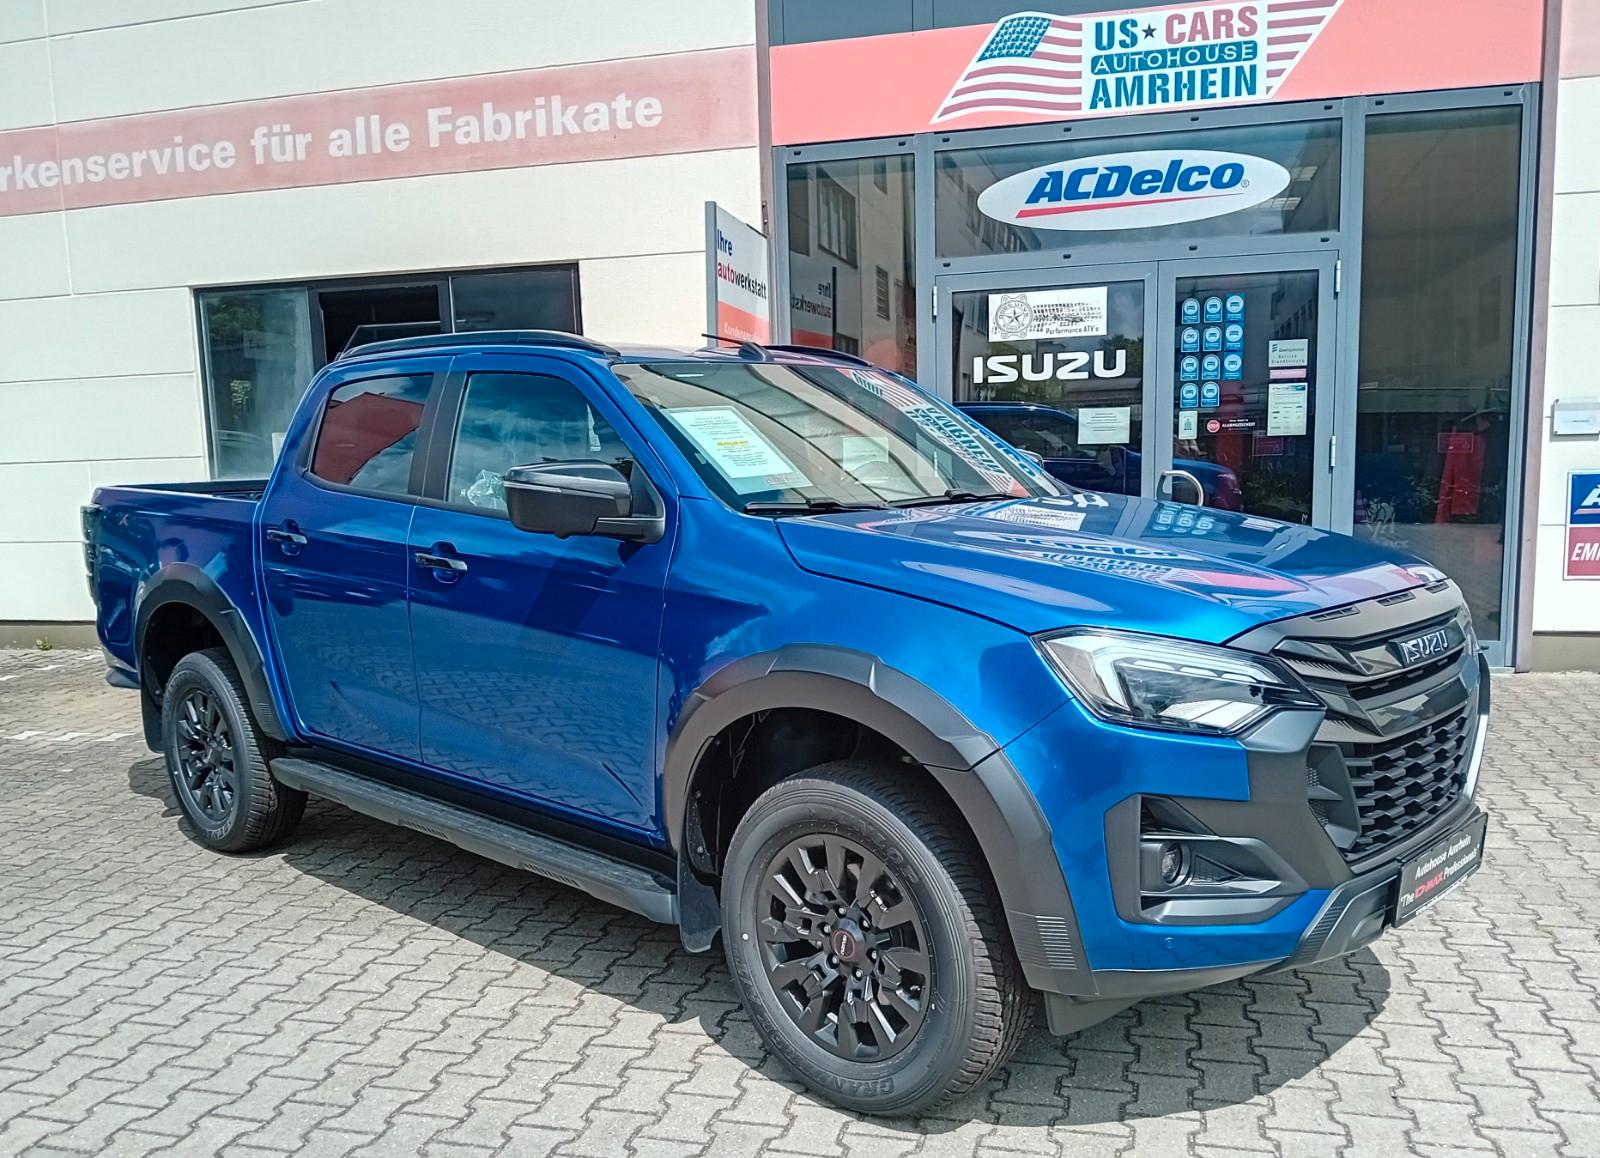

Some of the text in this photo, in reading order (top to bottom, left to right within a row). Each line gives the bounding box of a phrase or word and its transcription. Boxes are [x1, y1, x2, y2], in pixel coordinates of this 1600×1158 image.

[1095, 5, 1258, 51] US CARS
[1093, 42, 1256, 74] AUTOHOUSE
[1089, 64, 1257, 110] AMRHEIN
[250, 123, 313, 165] für
[328, 114, 411, 157] alle
[427, 92, 663, 148] Fabrikate
[1024, 159, 1245, 204] ACDelco
[717, 228, 733, 257] Ihre
[717, 261, 767, 300] autowerkstatt
[973, 349, 1126, 384] ISUZU
[1400, 629, 1449, 664] ISUZU
[1415, 833, 1472, 880] Autohouse Amrhein
